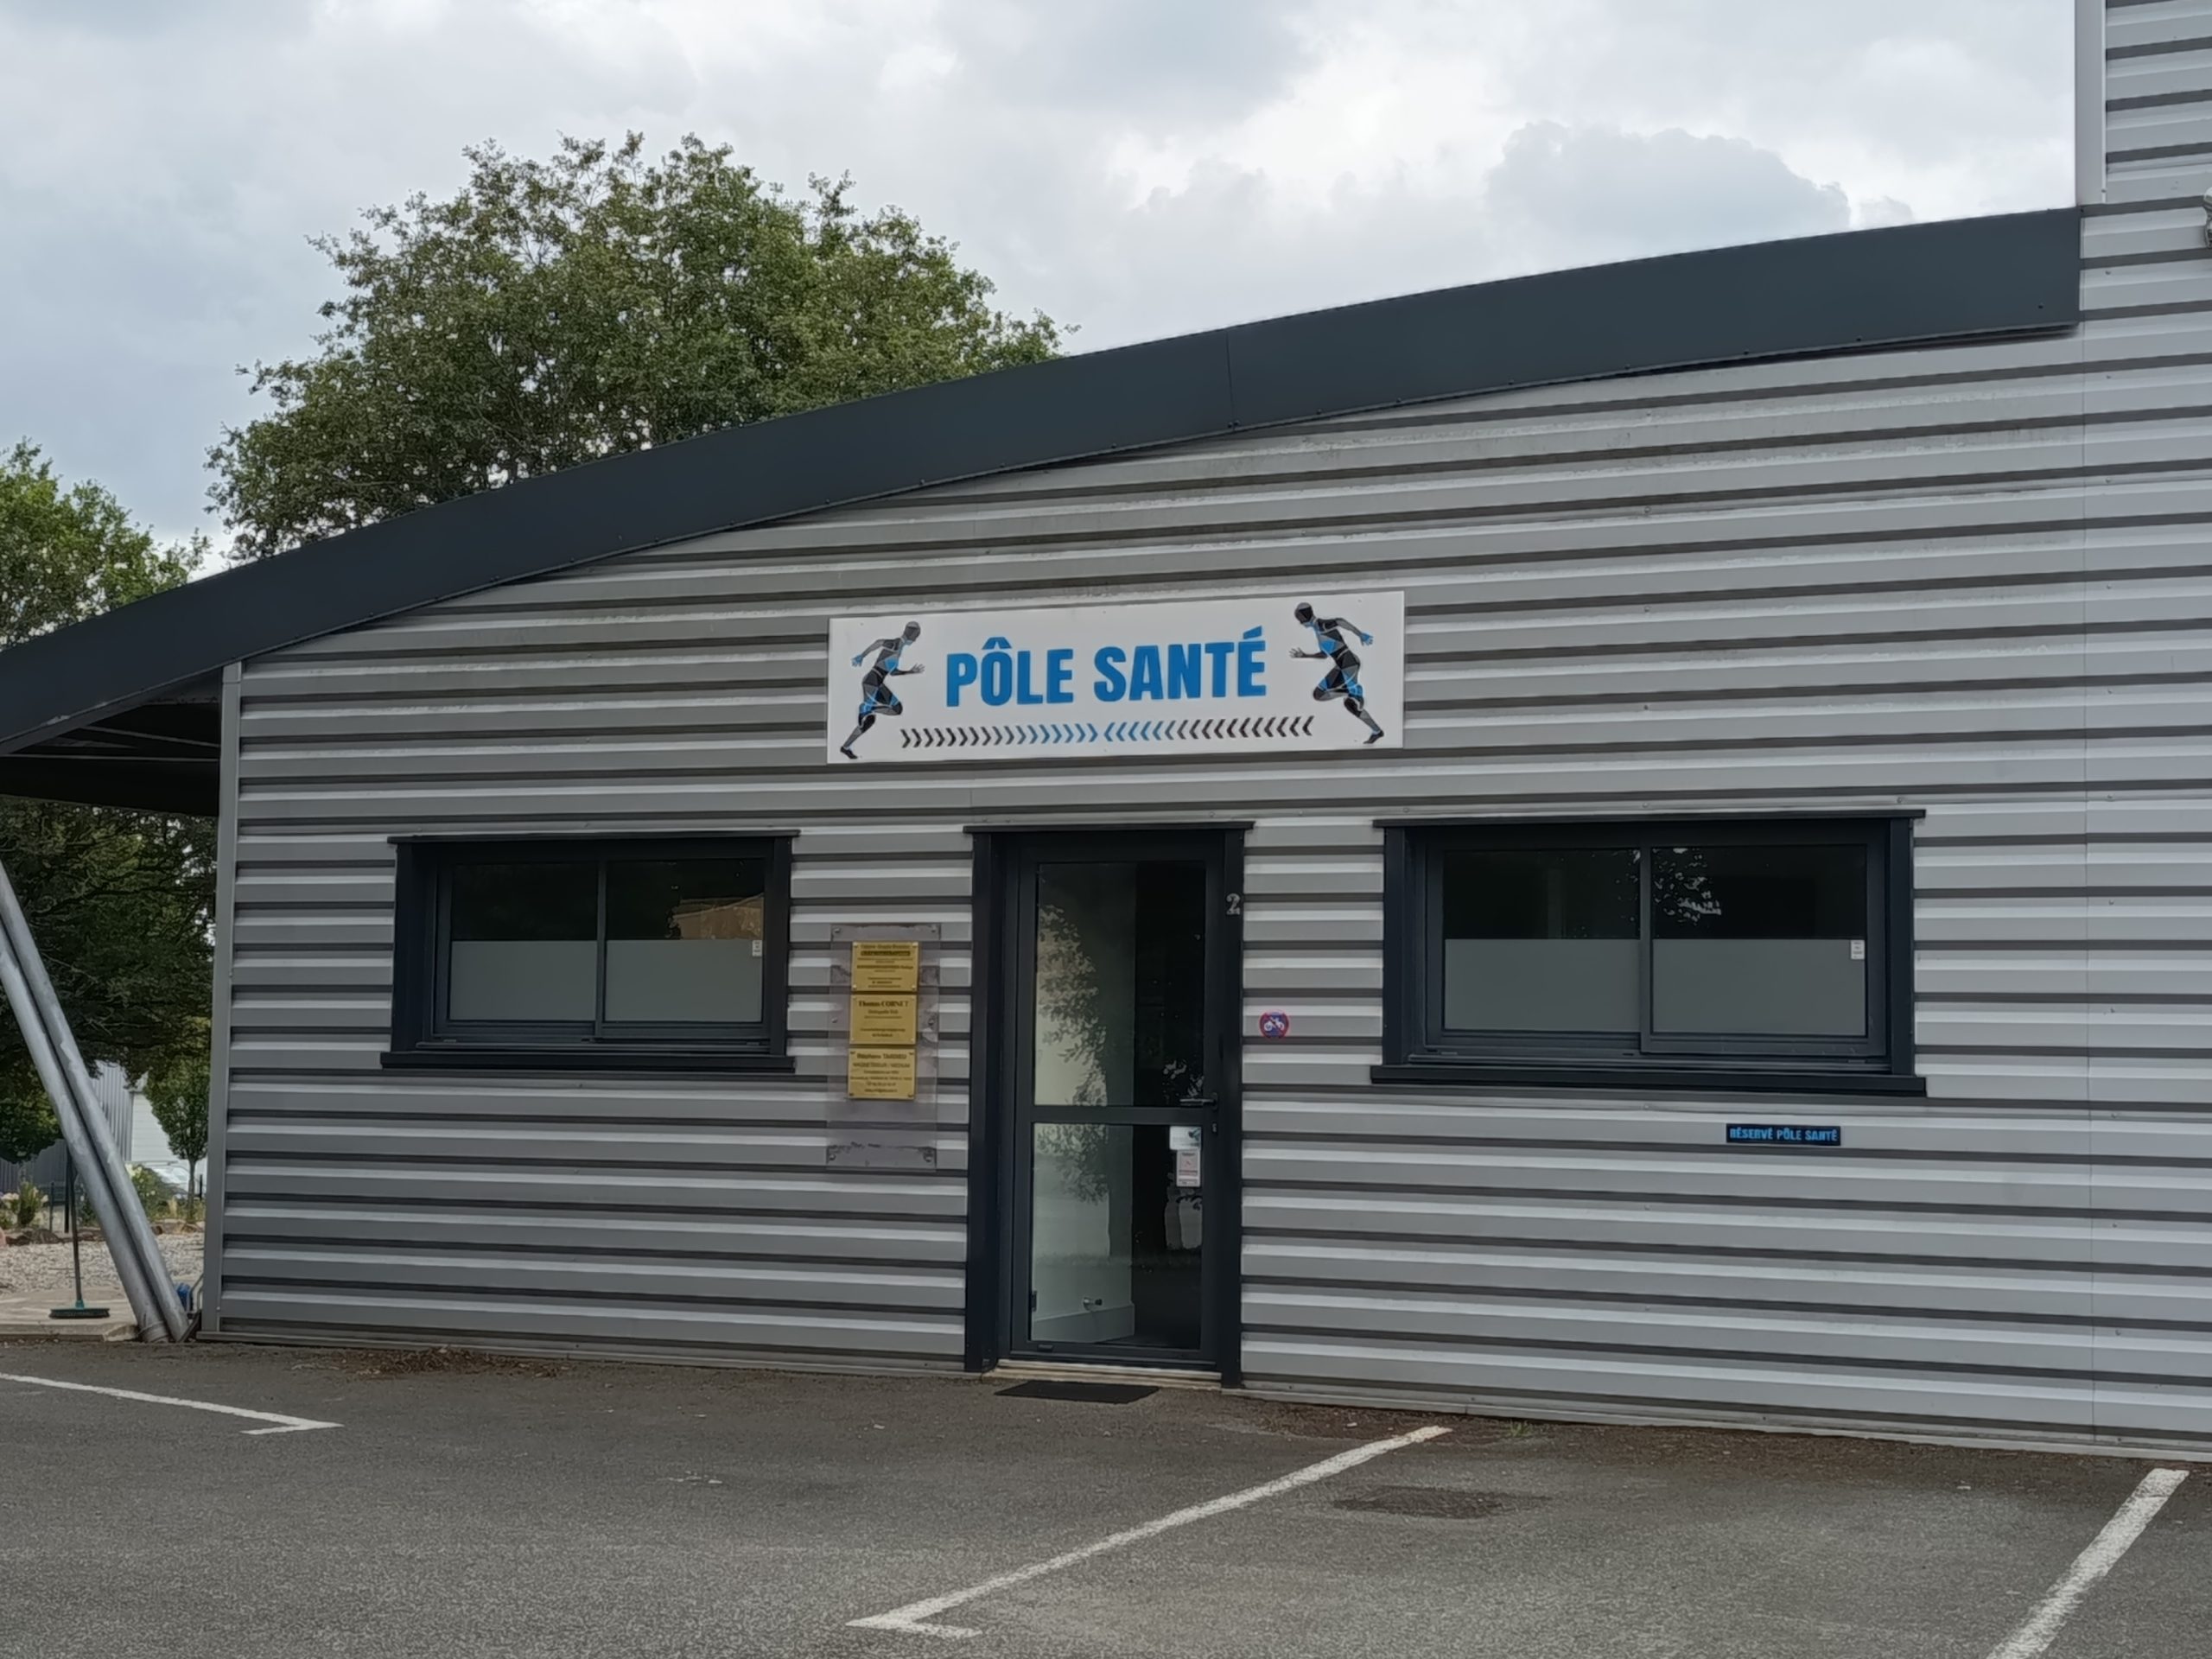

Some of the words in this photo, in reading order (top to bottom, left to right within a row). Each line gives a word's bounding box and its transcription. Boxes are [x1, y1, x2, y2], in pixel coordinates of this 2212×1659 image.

[945, 636, 1074, 708] PÔLE
[1093, 626, 1267, 702] SANTÉ
[1226, 893, 1241, 916] 2
[1729, 1127, 1773, 1140] RÉSERVÉ
[1777, 1127, 1802, 1141] PÔLE
[1805, 1128, 1838, 1141] SANTÉ
